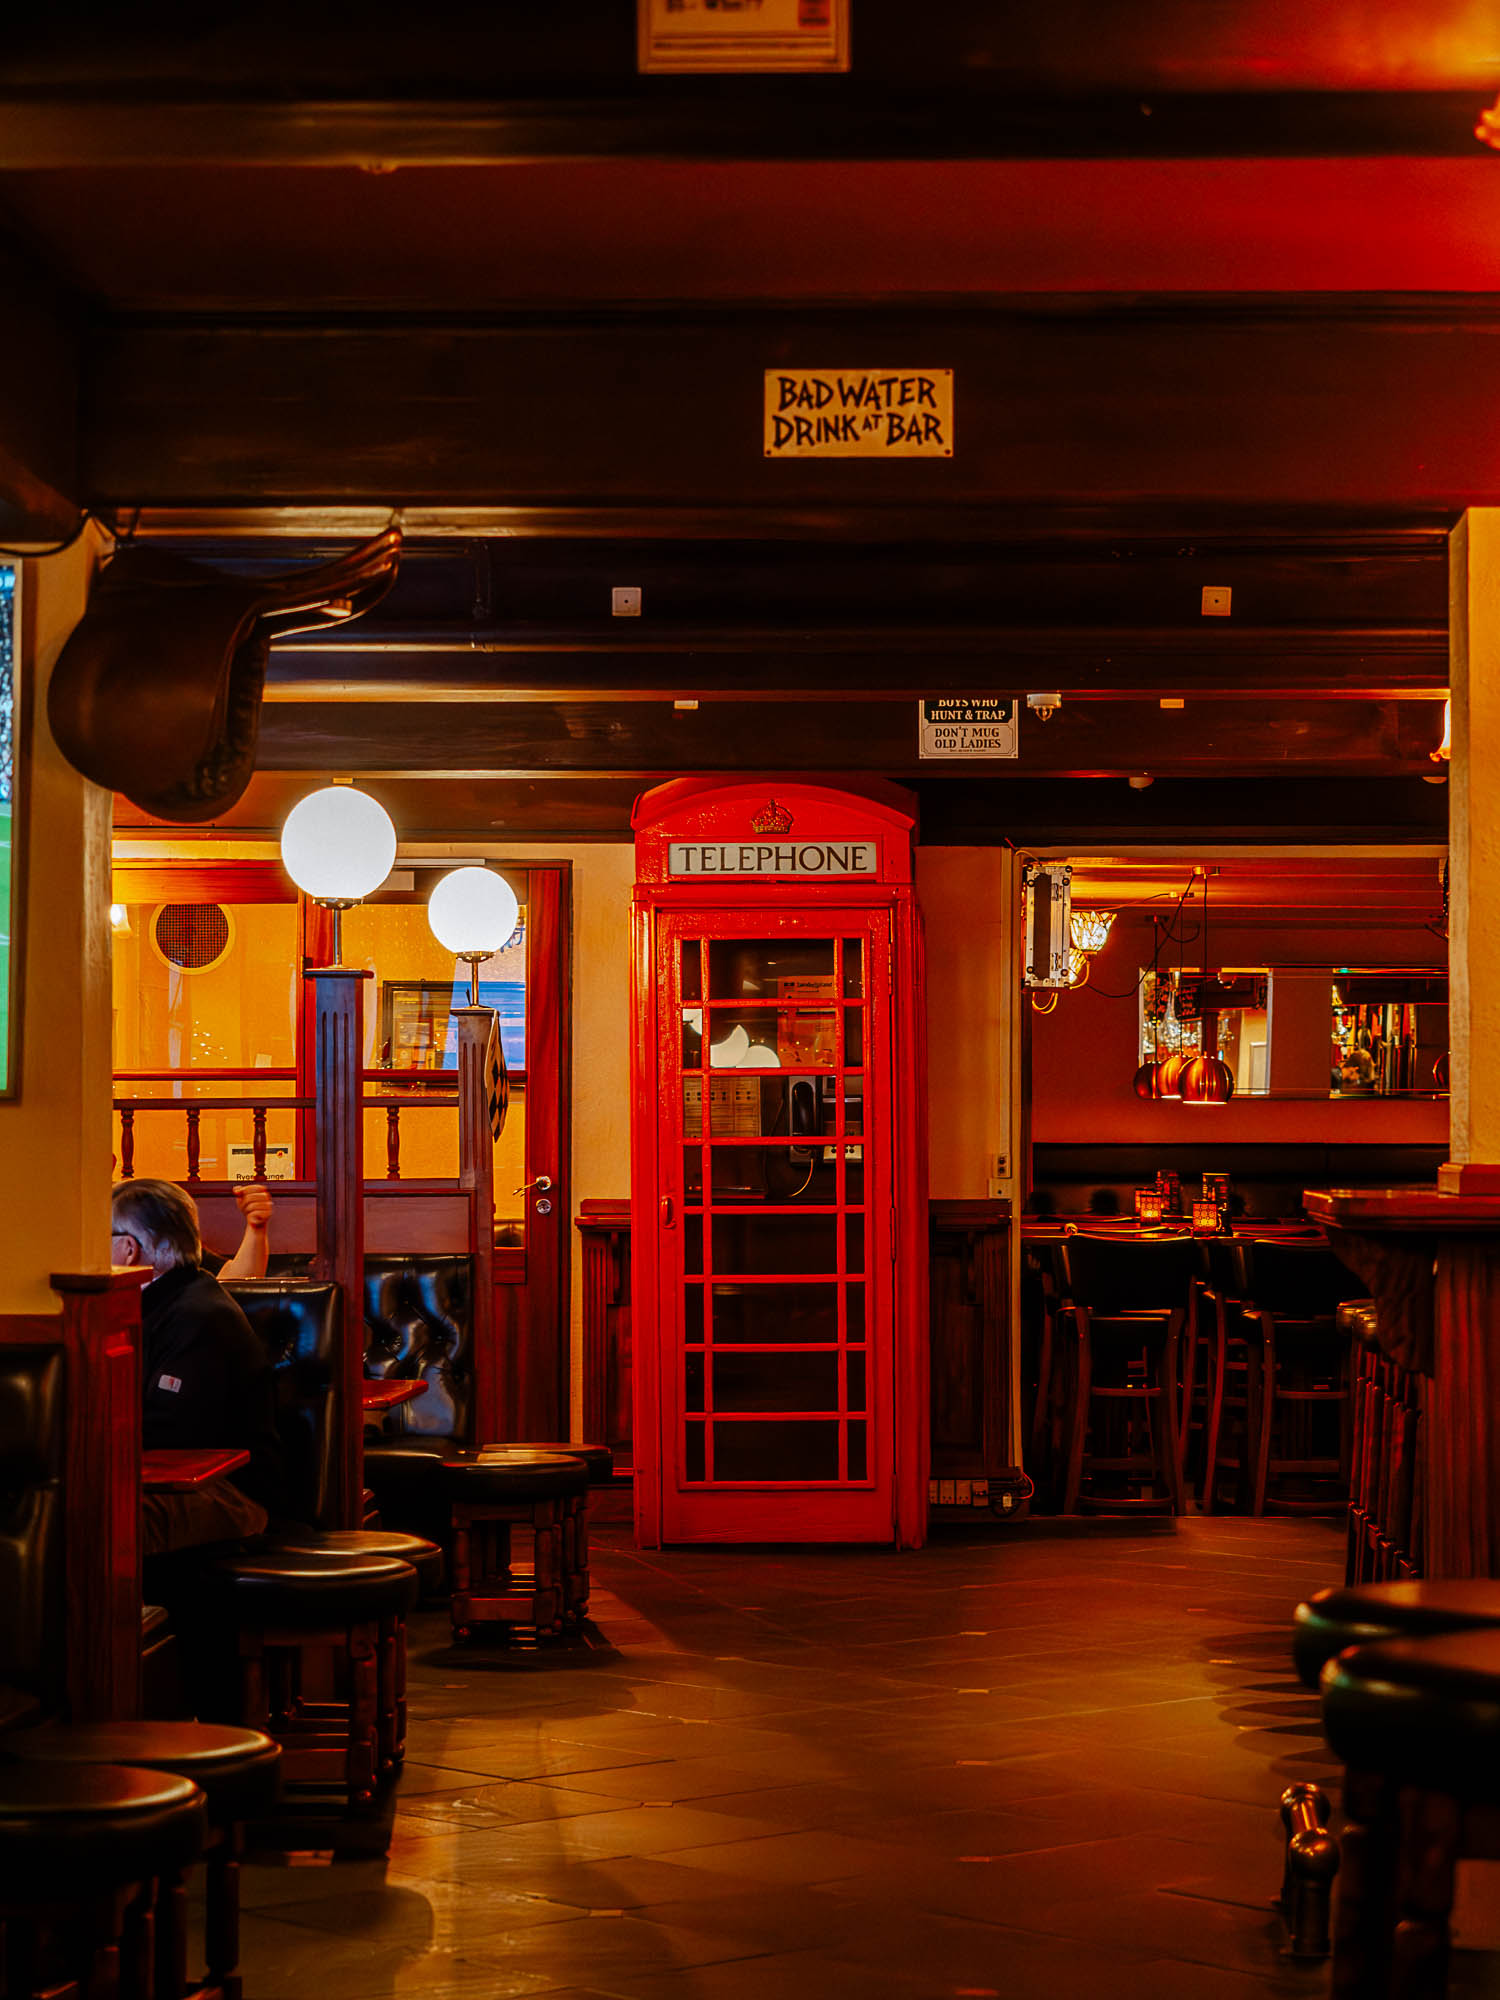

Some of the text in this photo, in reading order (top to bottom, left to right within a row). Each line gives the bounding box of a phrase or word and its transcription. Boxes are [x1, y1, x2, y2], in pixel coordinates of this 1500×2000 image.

[778, 376, 937, 411] BAD WATER
[772, 412, 944, 448] DRINK AT BAR
[931, 709, 1005, 721] HUNT & TRAP
[935, 726, 1000, 738] DON'T MUG
[935, 738, 1001, 749] OLD LADIES
[679, 846, 867, 872] TELEPHONE
